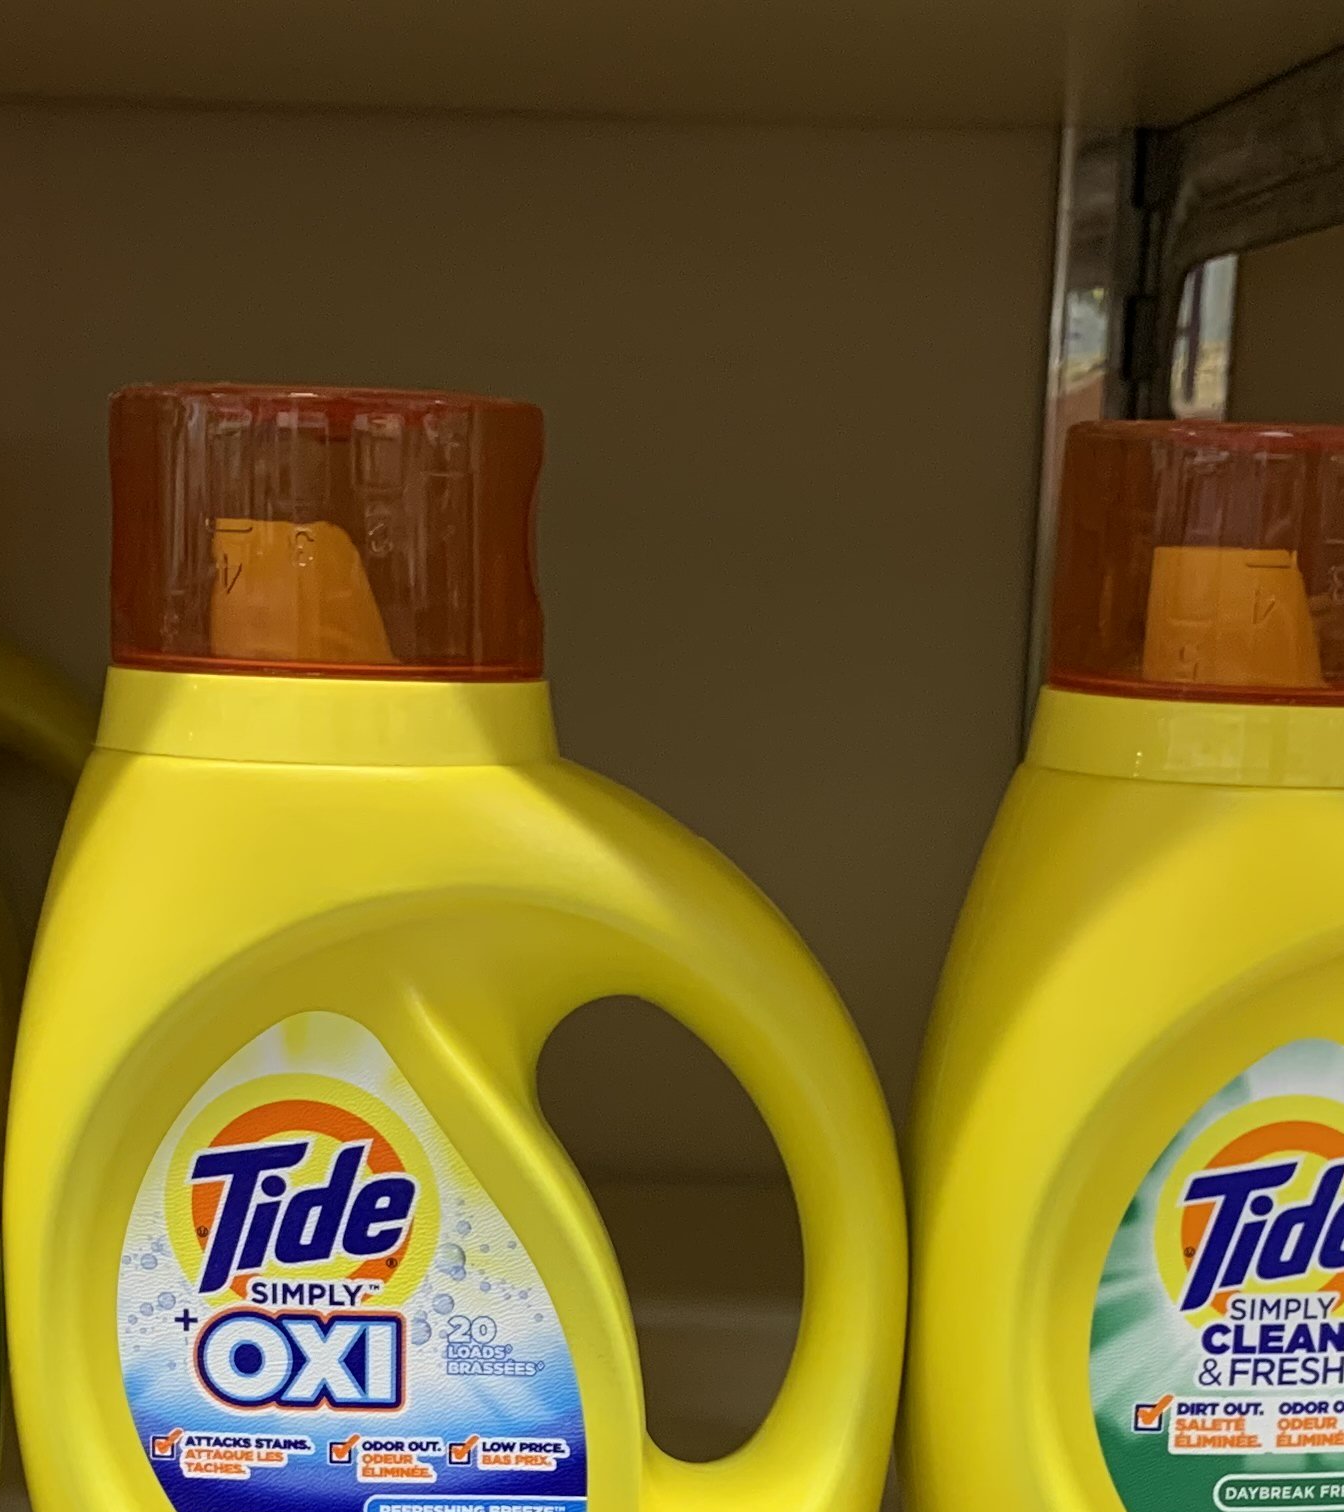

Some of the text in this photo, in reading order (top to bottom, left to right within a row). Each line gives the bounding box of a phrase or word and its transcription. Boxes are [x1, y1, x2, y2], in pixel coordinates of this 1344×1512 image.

[192, 1143, 416, 1294] Tide
[1231, 1298, 1335, 1321] SIMPLY
[446, 1315, 497, 1345] 20
[198, 1310, 405, 1410] OXI
[1198, 1359, 1222, 1386] &
[1177, 1403, 1264, 1416] DIRT OUT.
[185, 1436, 311, 1450] ATTACKS STAINS.
[1225, 1485, 1315, 1500] DAYBREAK
